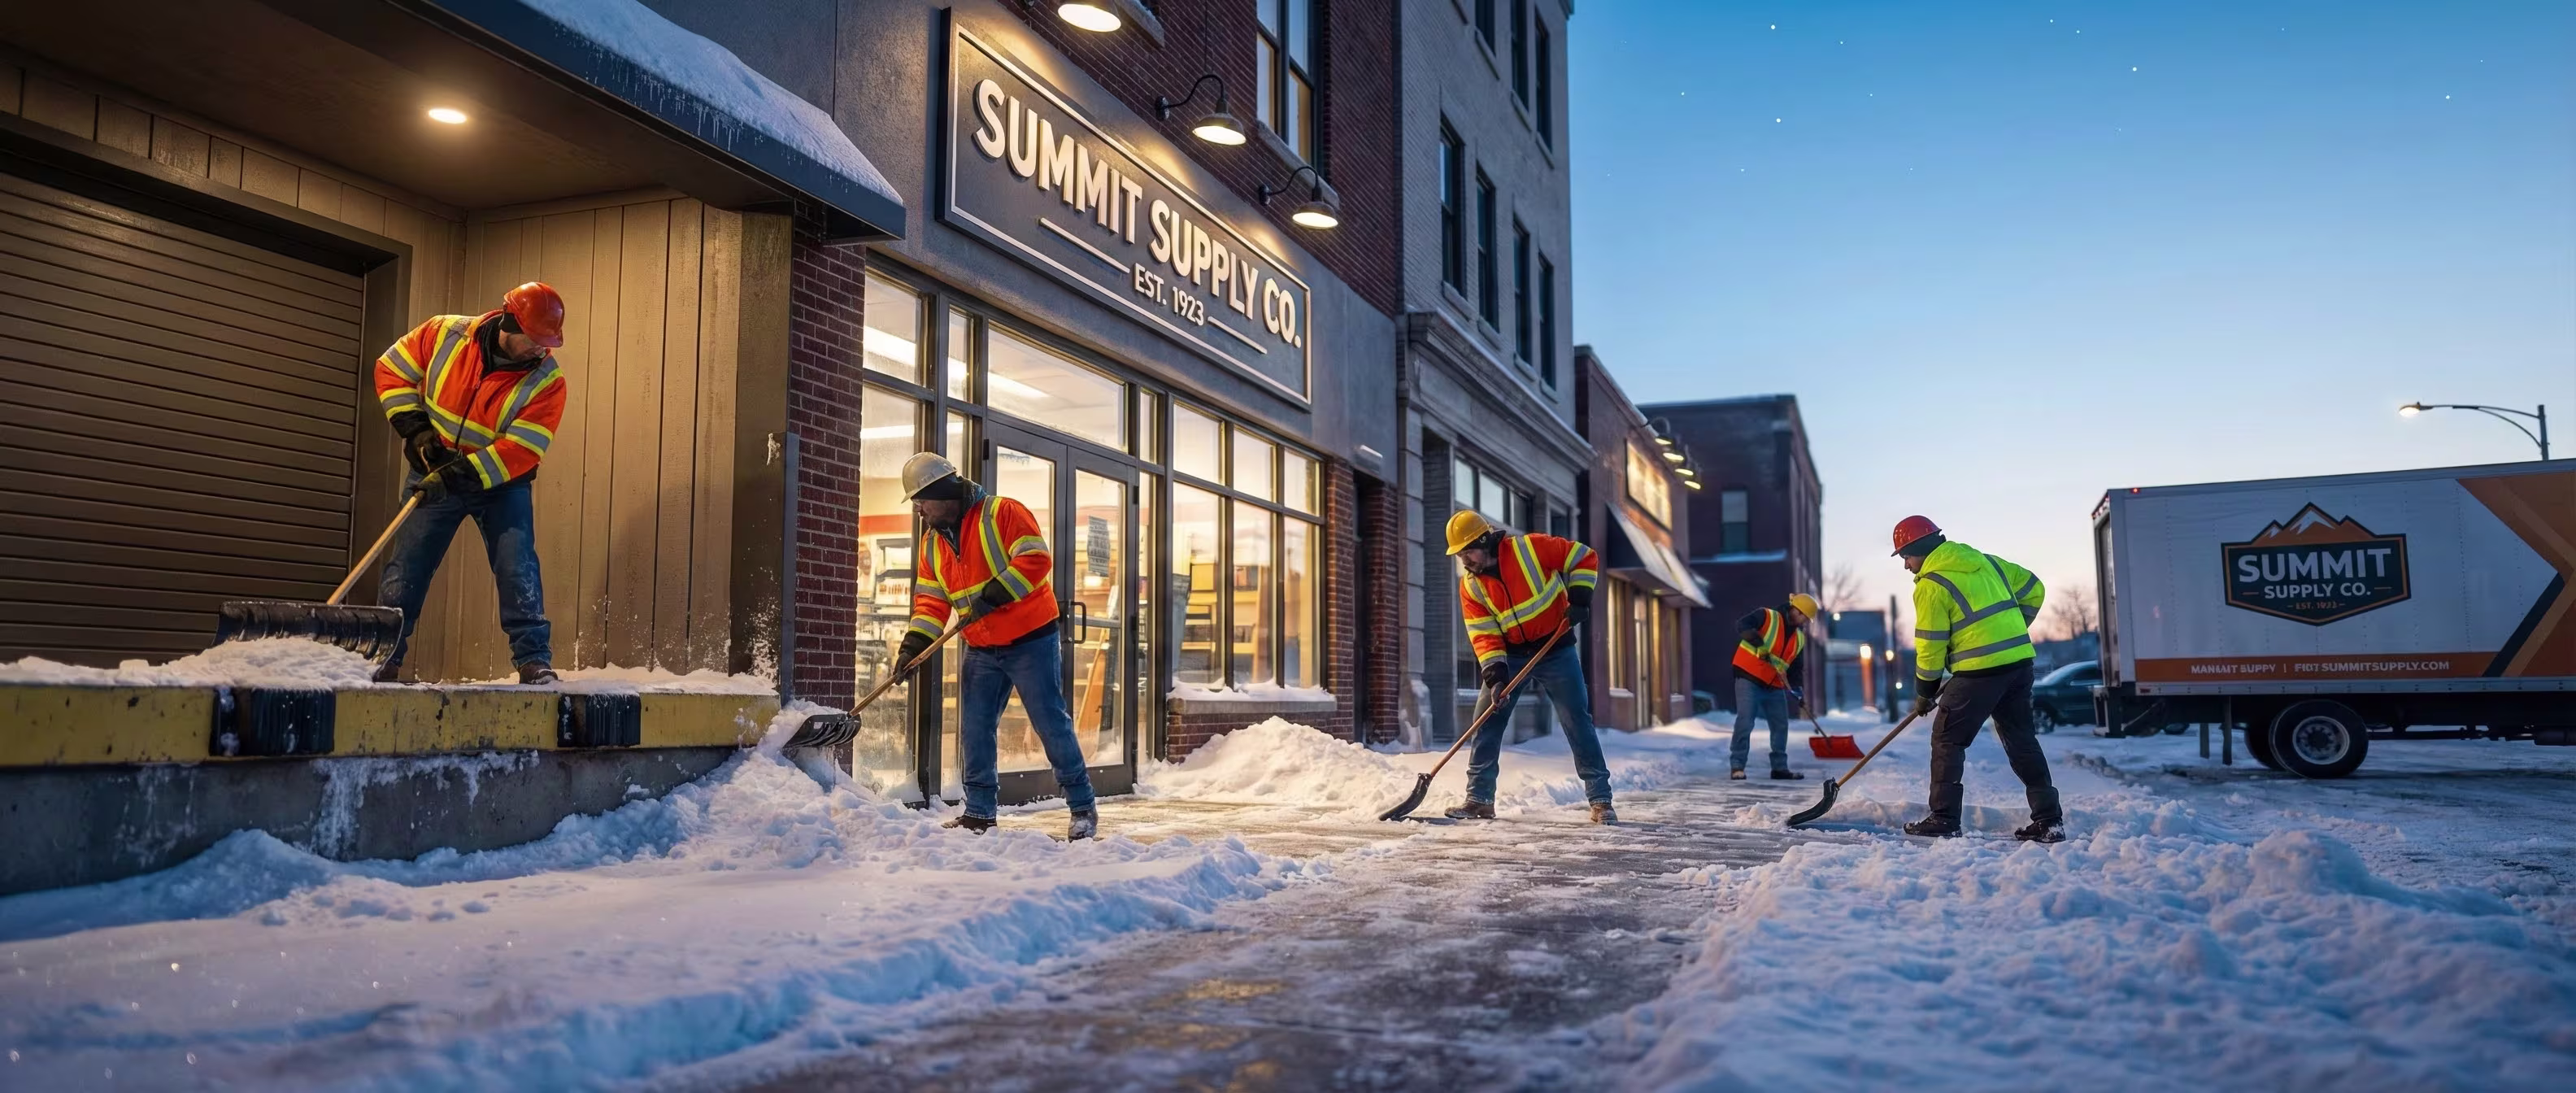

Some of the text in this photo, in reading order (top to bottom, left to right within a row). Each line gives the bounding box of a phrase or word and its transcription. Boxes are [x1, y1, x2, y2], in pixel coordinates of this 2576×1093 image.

[975, 78, 1303, 349] SUMMIT SUPPLY CO.
[1133, 262, 1205, 326] EST. 1923
[2238, 548, 2391, 583] SUMMIT
[2264, 582, 2372, 599] SUPPLY CO.
[2321, 661, 2450, 673] SUMMITSUPPLY.COM
